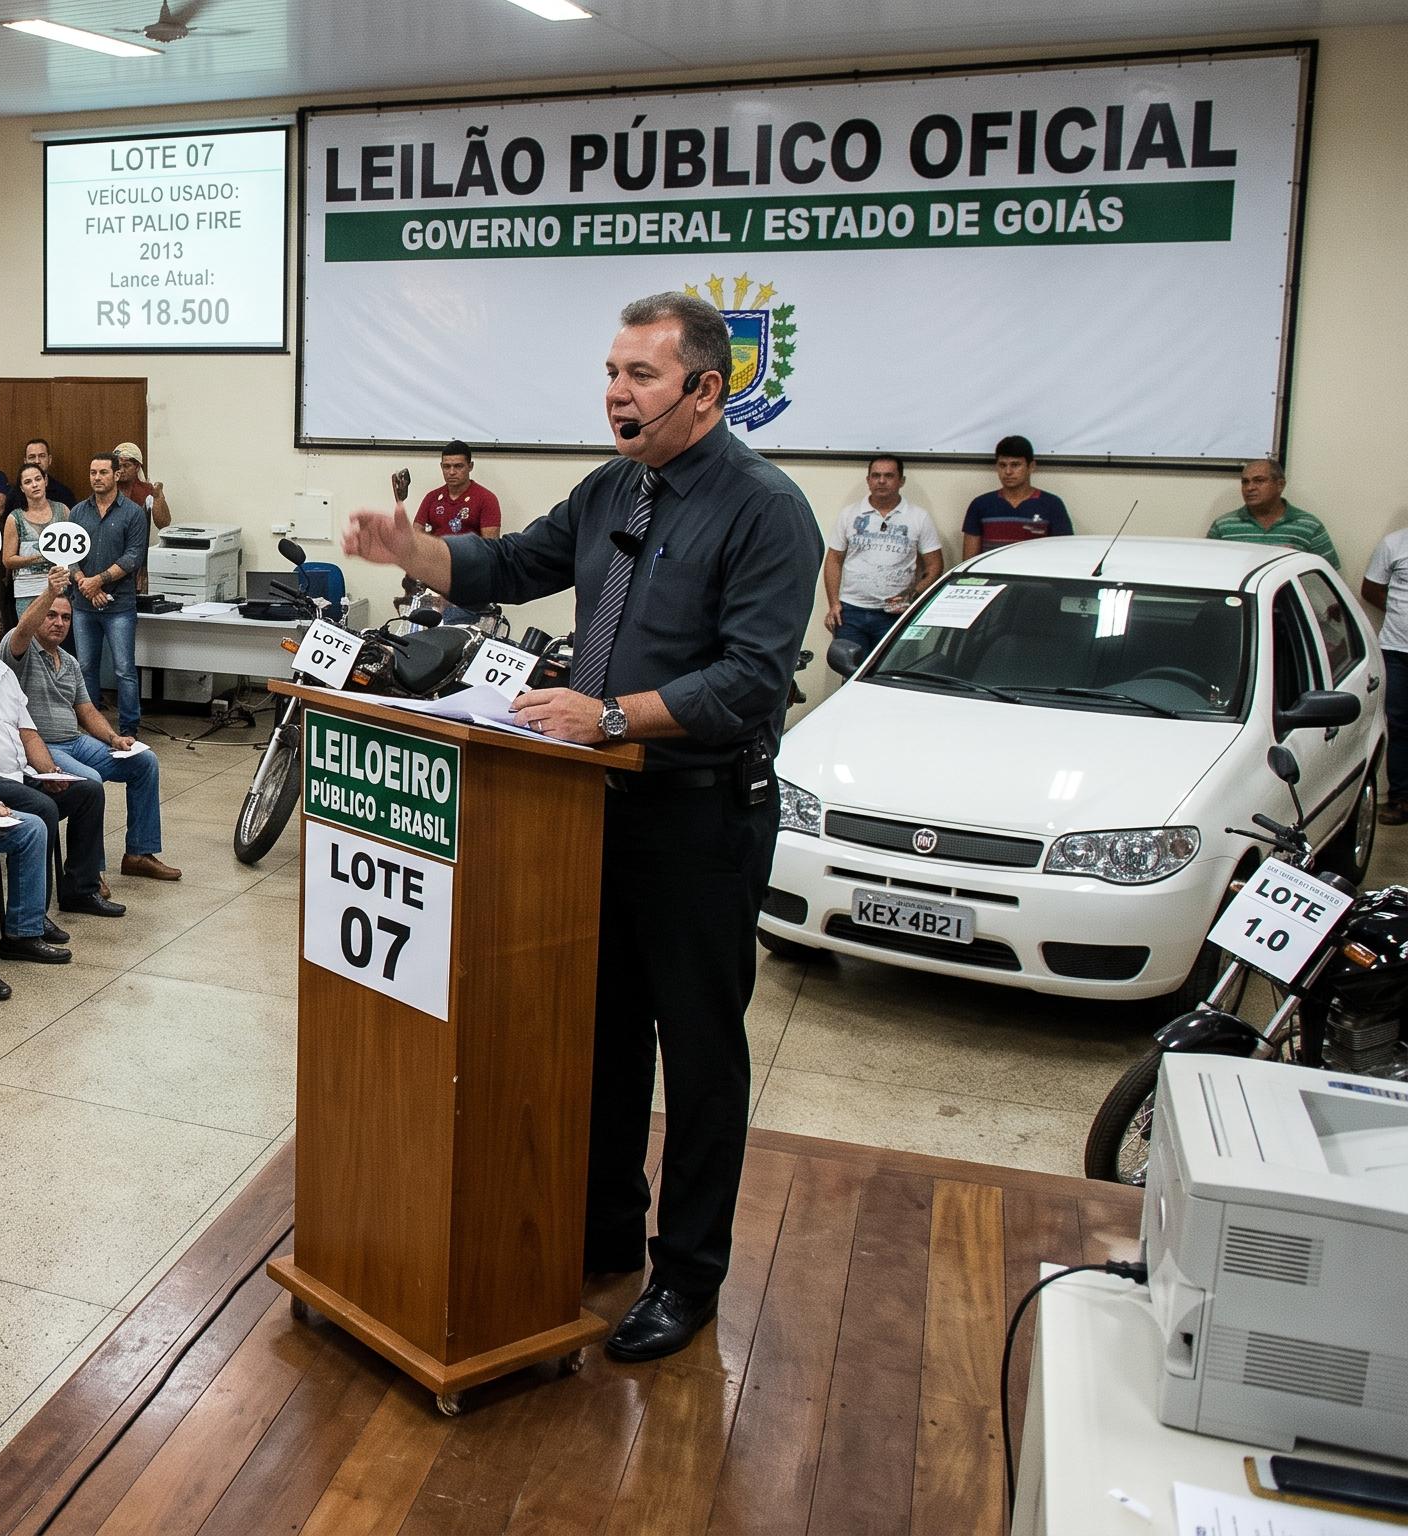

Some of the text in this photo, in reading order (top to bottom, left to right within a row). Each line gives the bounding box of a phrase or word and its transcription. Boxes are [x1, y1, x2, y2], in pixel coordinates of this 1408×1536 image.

[110, 143, 215, 171] LOTE 07
[325, 100, 1238, 203] LEILÃO PÚBLICO OFICIAL
[87, 183, 240, 206] VEÍCULO USADO:
[85, 210, 242, 235] FIAT PALIO FIRE
[401, 216, 561, 251] GOVERNO
[573, 210, 731, 246] FEDERAL
[764, 204, 915, 241] ESTADO
[929, 201, 981, 237] DE
[993, 189, 1124, 235] GOIÁS
[139, 241, 184, 260] 2013
[110, 269, 215, 288] Lance Atual:
[96, 298, 230, 328] R$ 18.500
[42, 532, 86, 554] 203
[312, 629, 353, 655] LOTE
[311, 649, 337, 670] 07
[485, 649, 526, 672] LOTE
[485, 668, 512, 686] 07
[311, 725, 451, 804] LEILOEIRO
[311, 777, 376, 821] PÚBLICO
[390, 802, 450, 846] BRASIL
[330, 843, 424, 911] LOTE
[1255, 878, 1326, 923] LOTE
[340, 905, 411, 982] 07
[1244, 917, 1290, 951] 1.0
